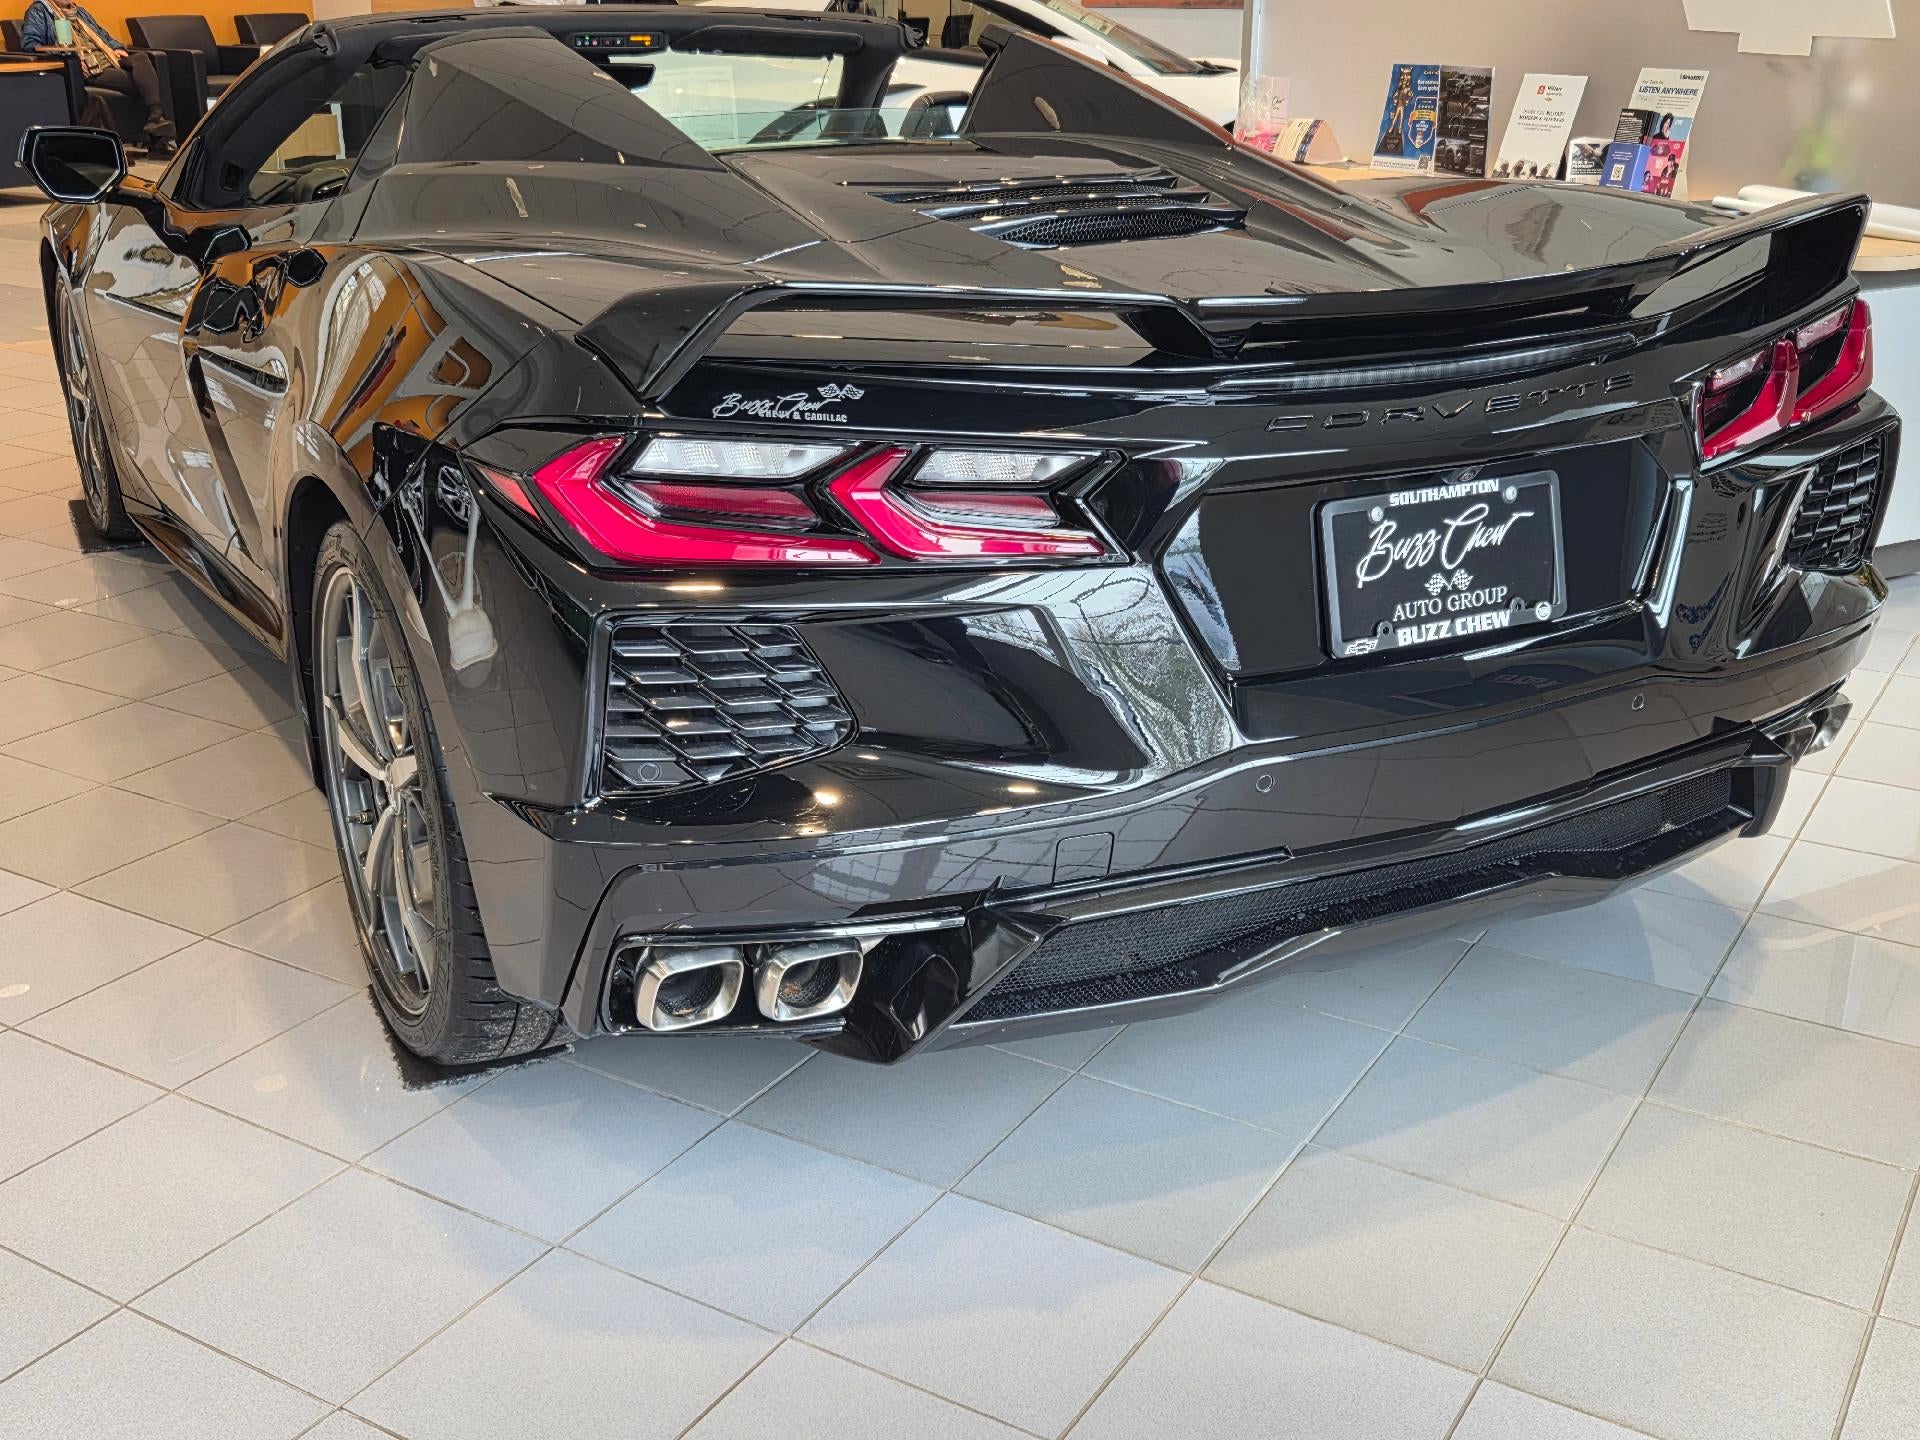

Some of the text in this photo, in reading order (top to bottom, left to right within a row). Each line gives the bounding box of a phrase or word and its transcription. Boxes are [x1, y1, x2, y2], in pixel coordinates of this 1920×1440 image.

[1639, 85, 1699, 96] LISTEN ANYWHERE
[712, 392, 841, 418] Buzz Chew
[793, 412, 802, 420] &
[804, 412, 848, 423] CADILLAC
[1265, 371, 1635, 434] CORVETTE
[1389, 478, 1500, 506] SOUTHAMPTON
[1356, 503, 1535, 588] Buzz Chew
[1393, 585, 1508, 622] AUTO GROUP
[1397, 622, 1452, 647] BUZZ
[1454, 609, 1511, 634] CHEW
